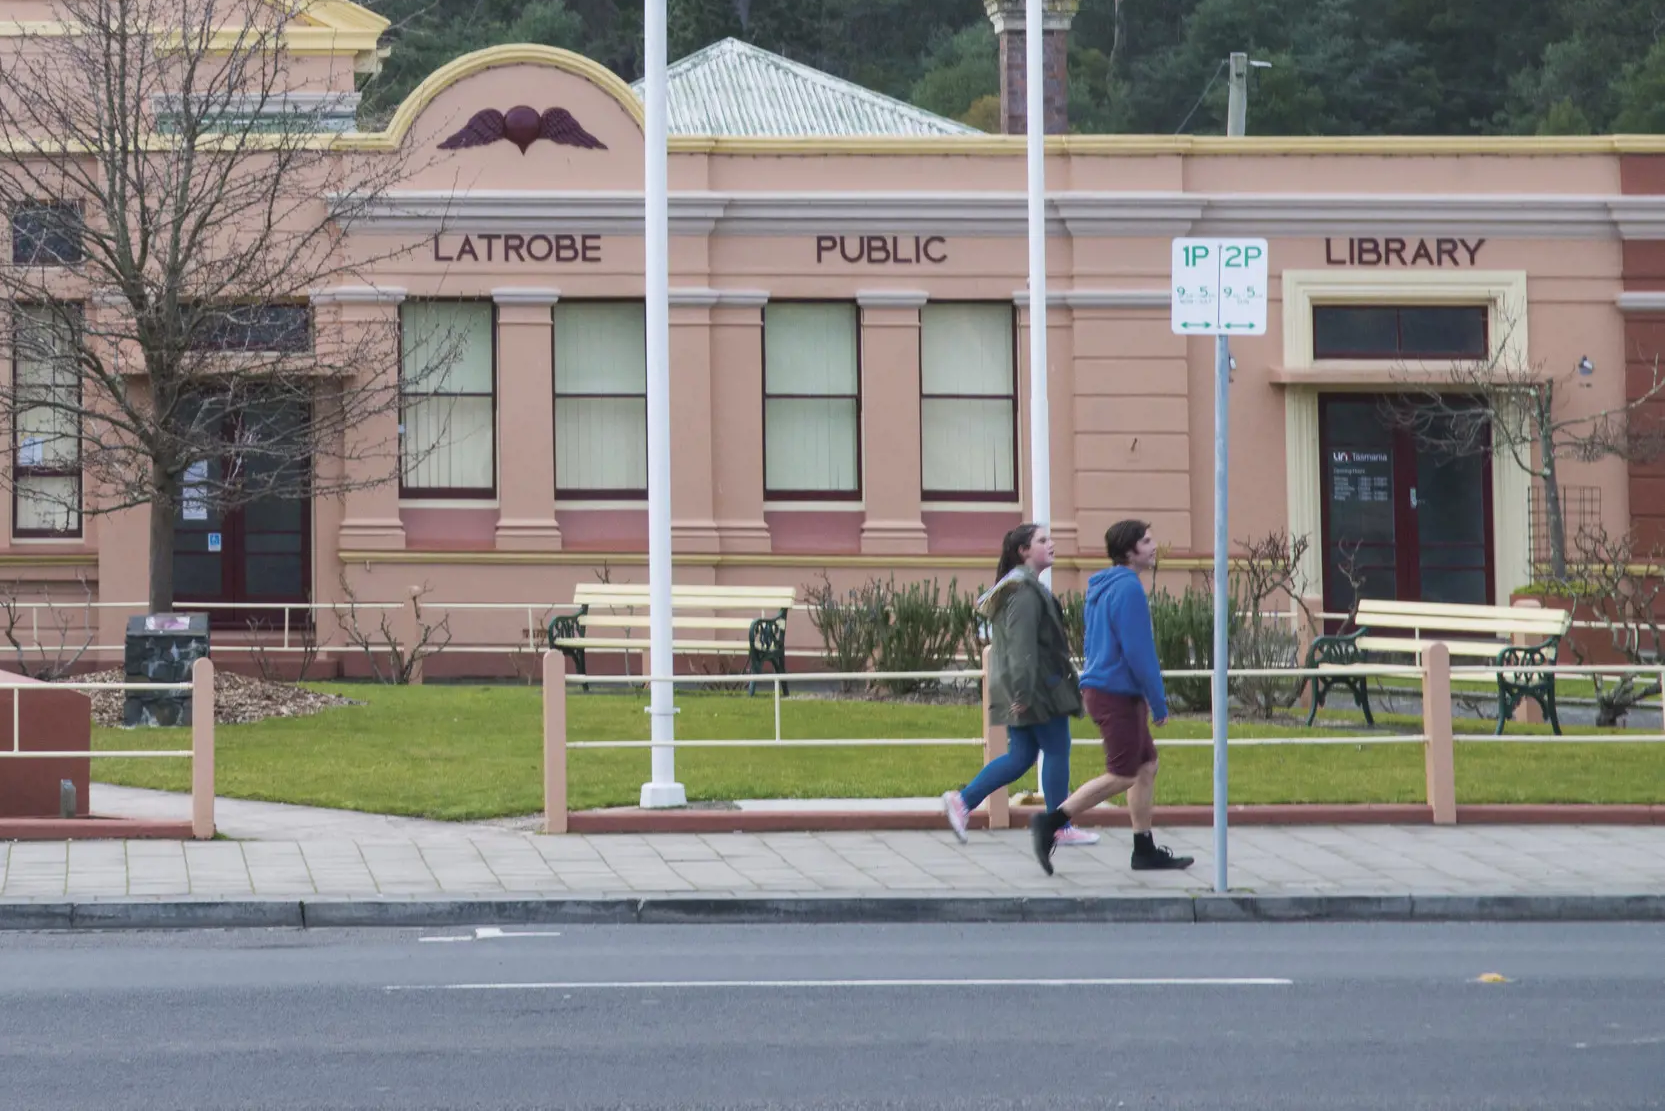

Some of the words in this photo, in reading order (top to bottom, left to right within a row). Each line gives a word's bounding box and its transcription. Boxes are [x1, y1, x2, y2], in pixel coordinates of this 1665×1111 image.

[434, 234, 602, 263] LATROBE
[816, 235, 948, 265] PUBLIC
[1324, 237, 1485, 267] LIBRARY
[1182, 245, 1209, 267] 1P
[1224, 245, 1262, 267] 2P
[1352, 452, 1388, 462] Tasmania
